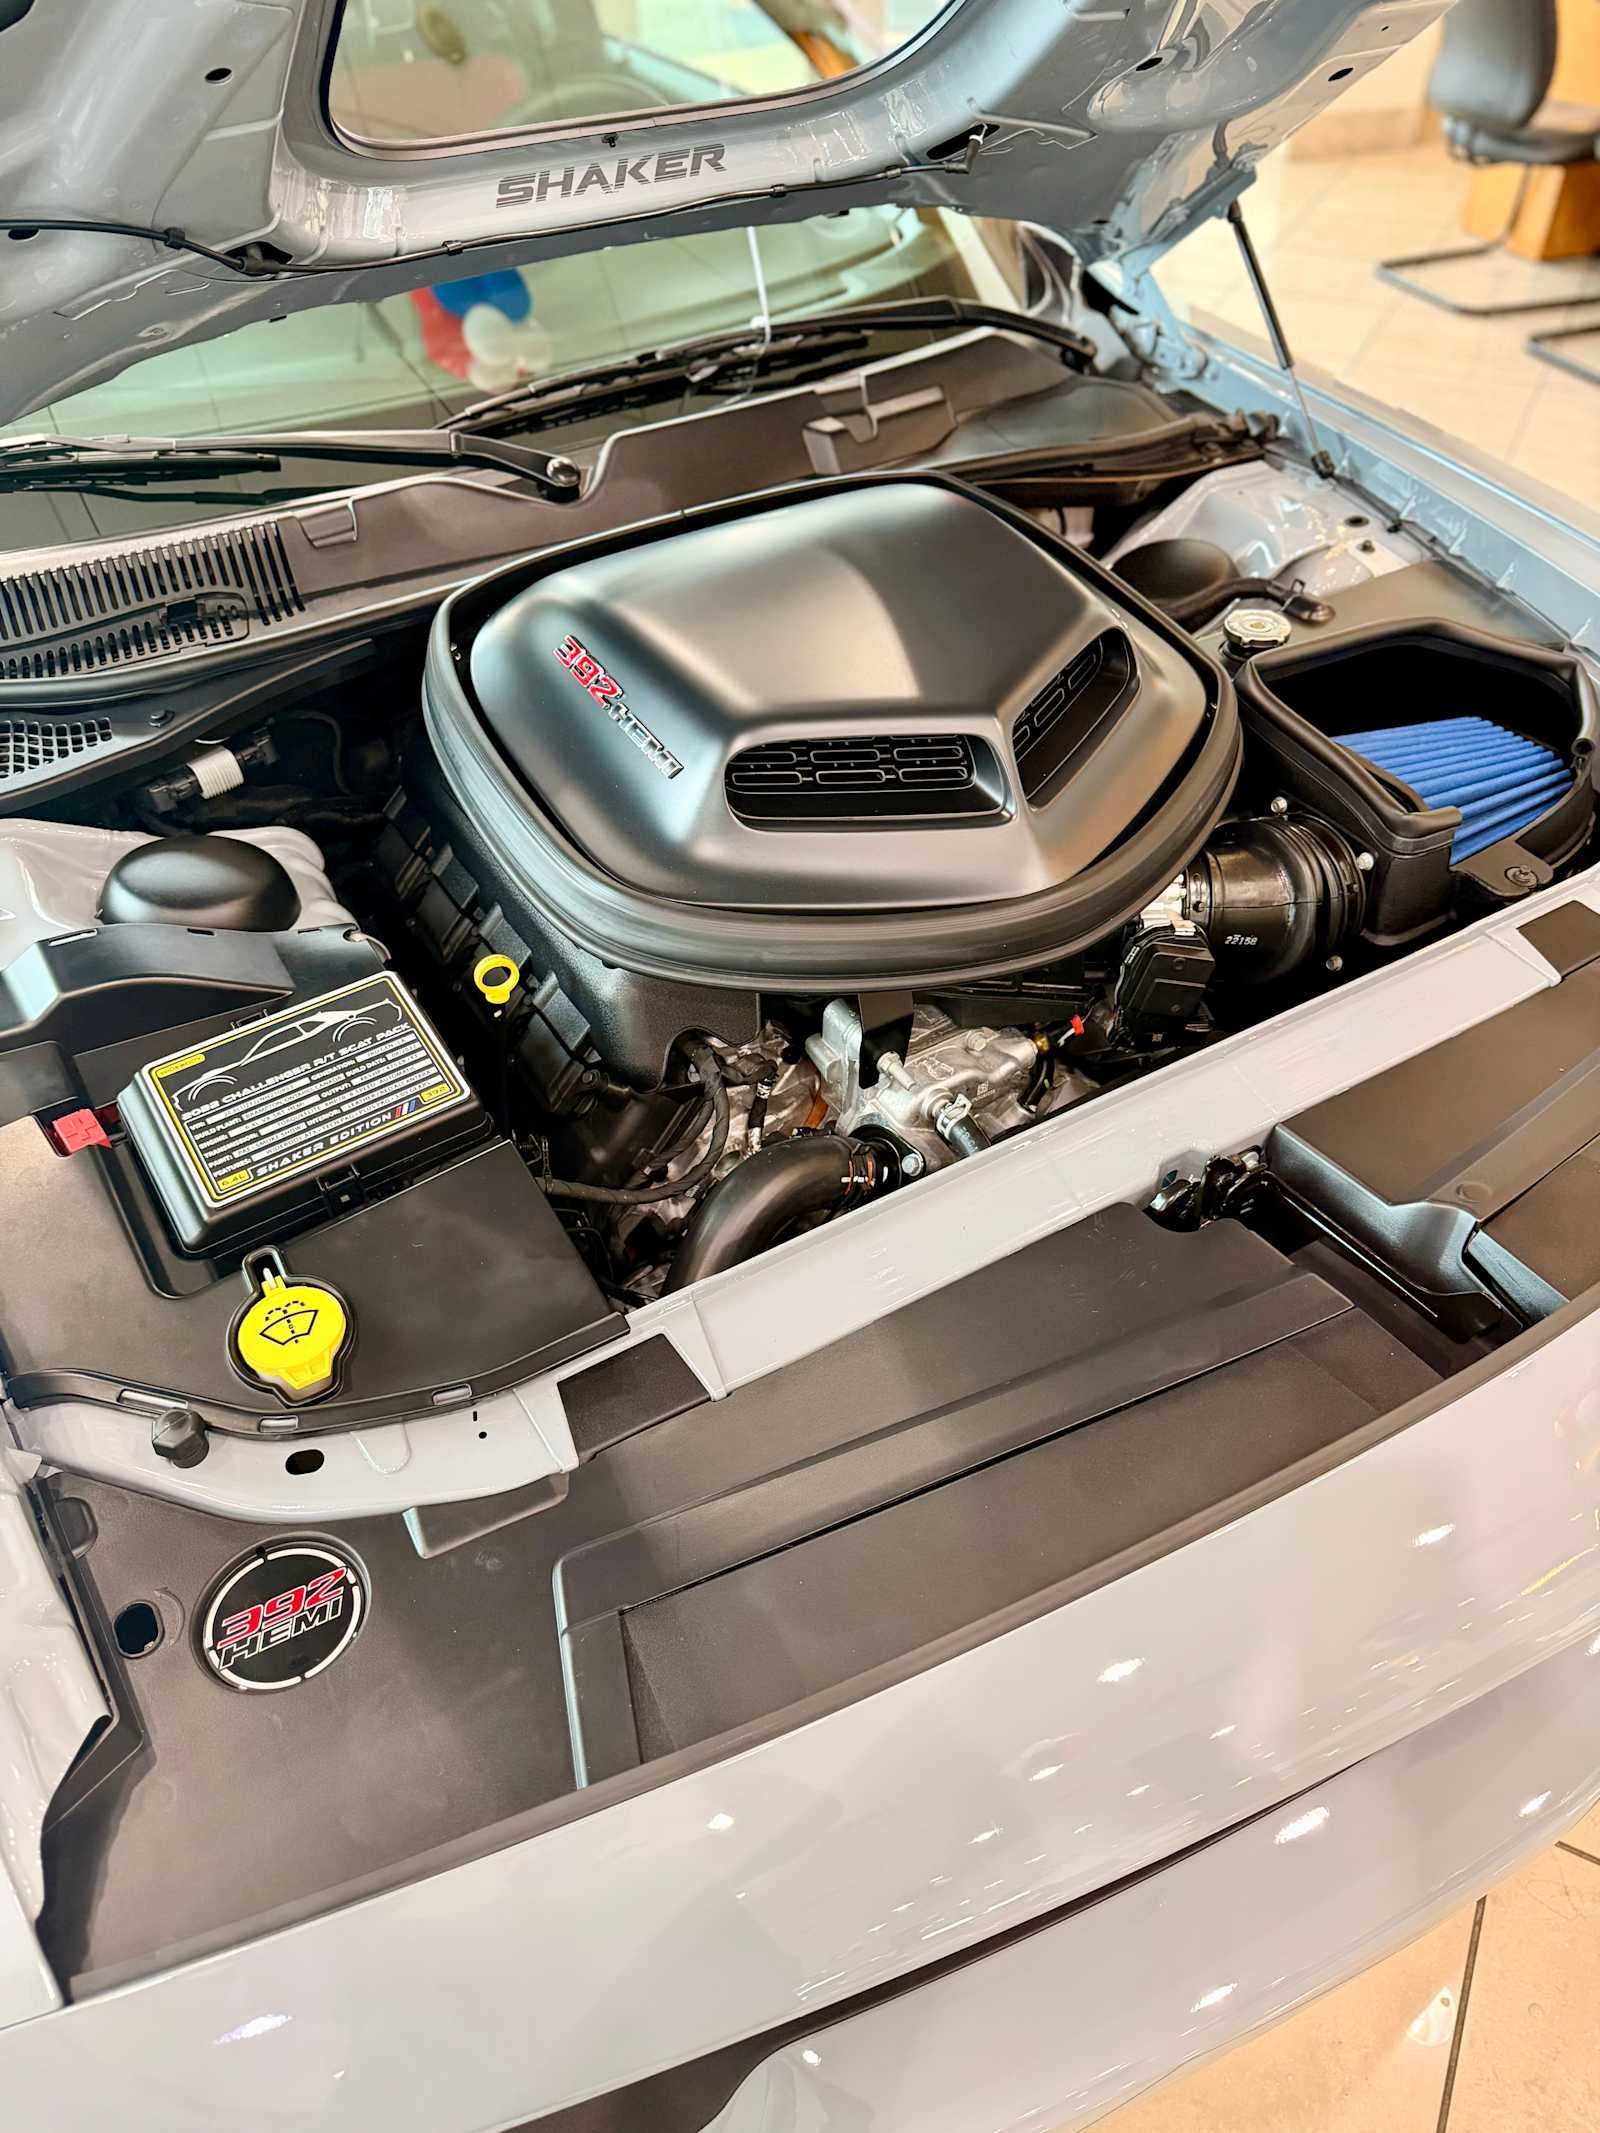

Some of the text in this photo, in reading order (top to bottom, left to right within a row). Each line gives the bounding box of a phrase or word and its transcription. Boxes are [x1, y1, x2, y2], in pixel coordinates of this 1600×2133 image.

[496, 143, 727, 209] SHAKER
[553, 635, 685, 780] 392 HEMI
[181, 1100, 219, 1120] 2022
[221, 1063, 311, 1104] CHALLENGER
[311, 1051, 337, 1066] R/T
[338, 1037, 373, 1055] SCAT
[375, 1023, 409, 1040] PACK
[255, 1112, 393, 1176] SHAKER EDITION
[217, 1567, 347, 1649] 392
[219, 1595, 343, 1669] HEMI
